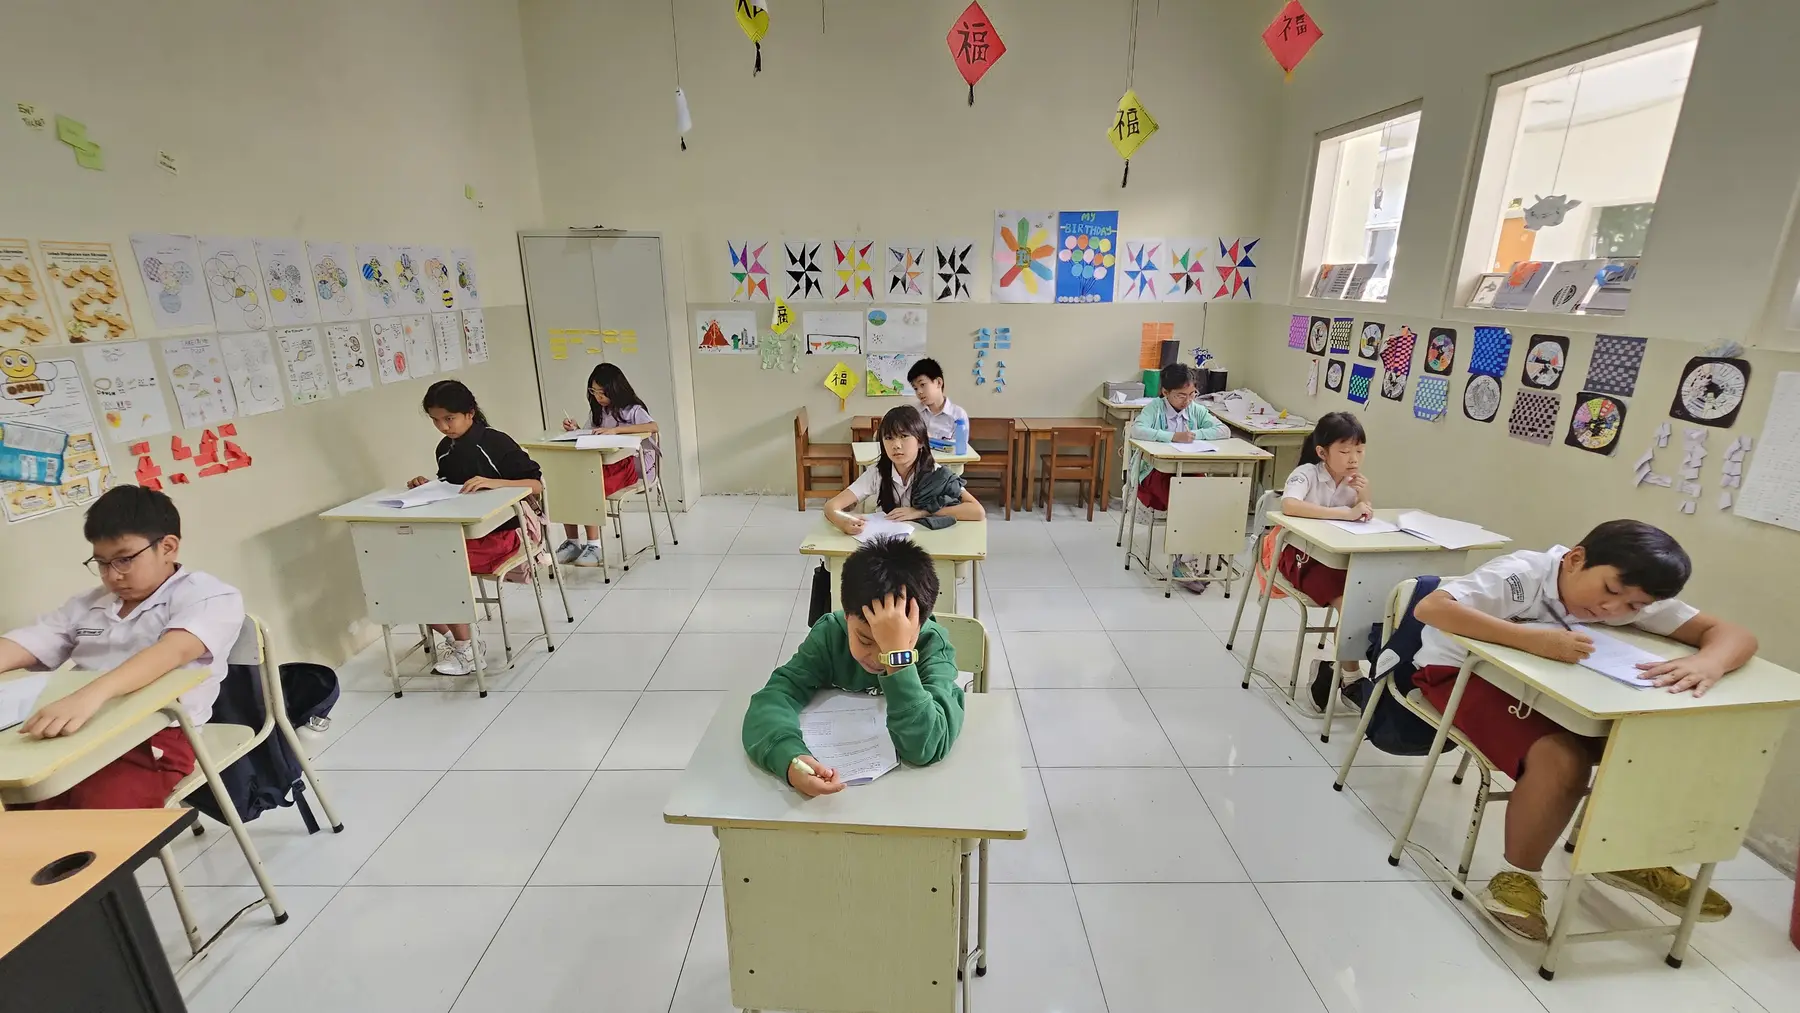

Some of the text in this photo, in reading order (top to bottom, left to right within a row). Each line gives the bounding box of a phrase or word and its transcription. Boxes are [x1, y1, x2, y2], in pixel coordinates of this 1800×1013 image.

[1278, 13, 1307, 42] 福
[957, 21, 989, 65] 福
[1113, 108, 1140, 141] 福
[1081, 212, 1096, 222] MY
[1064, 223, 1112, 236] BIRTHDAY
[831, 370, 847, 386] 福
